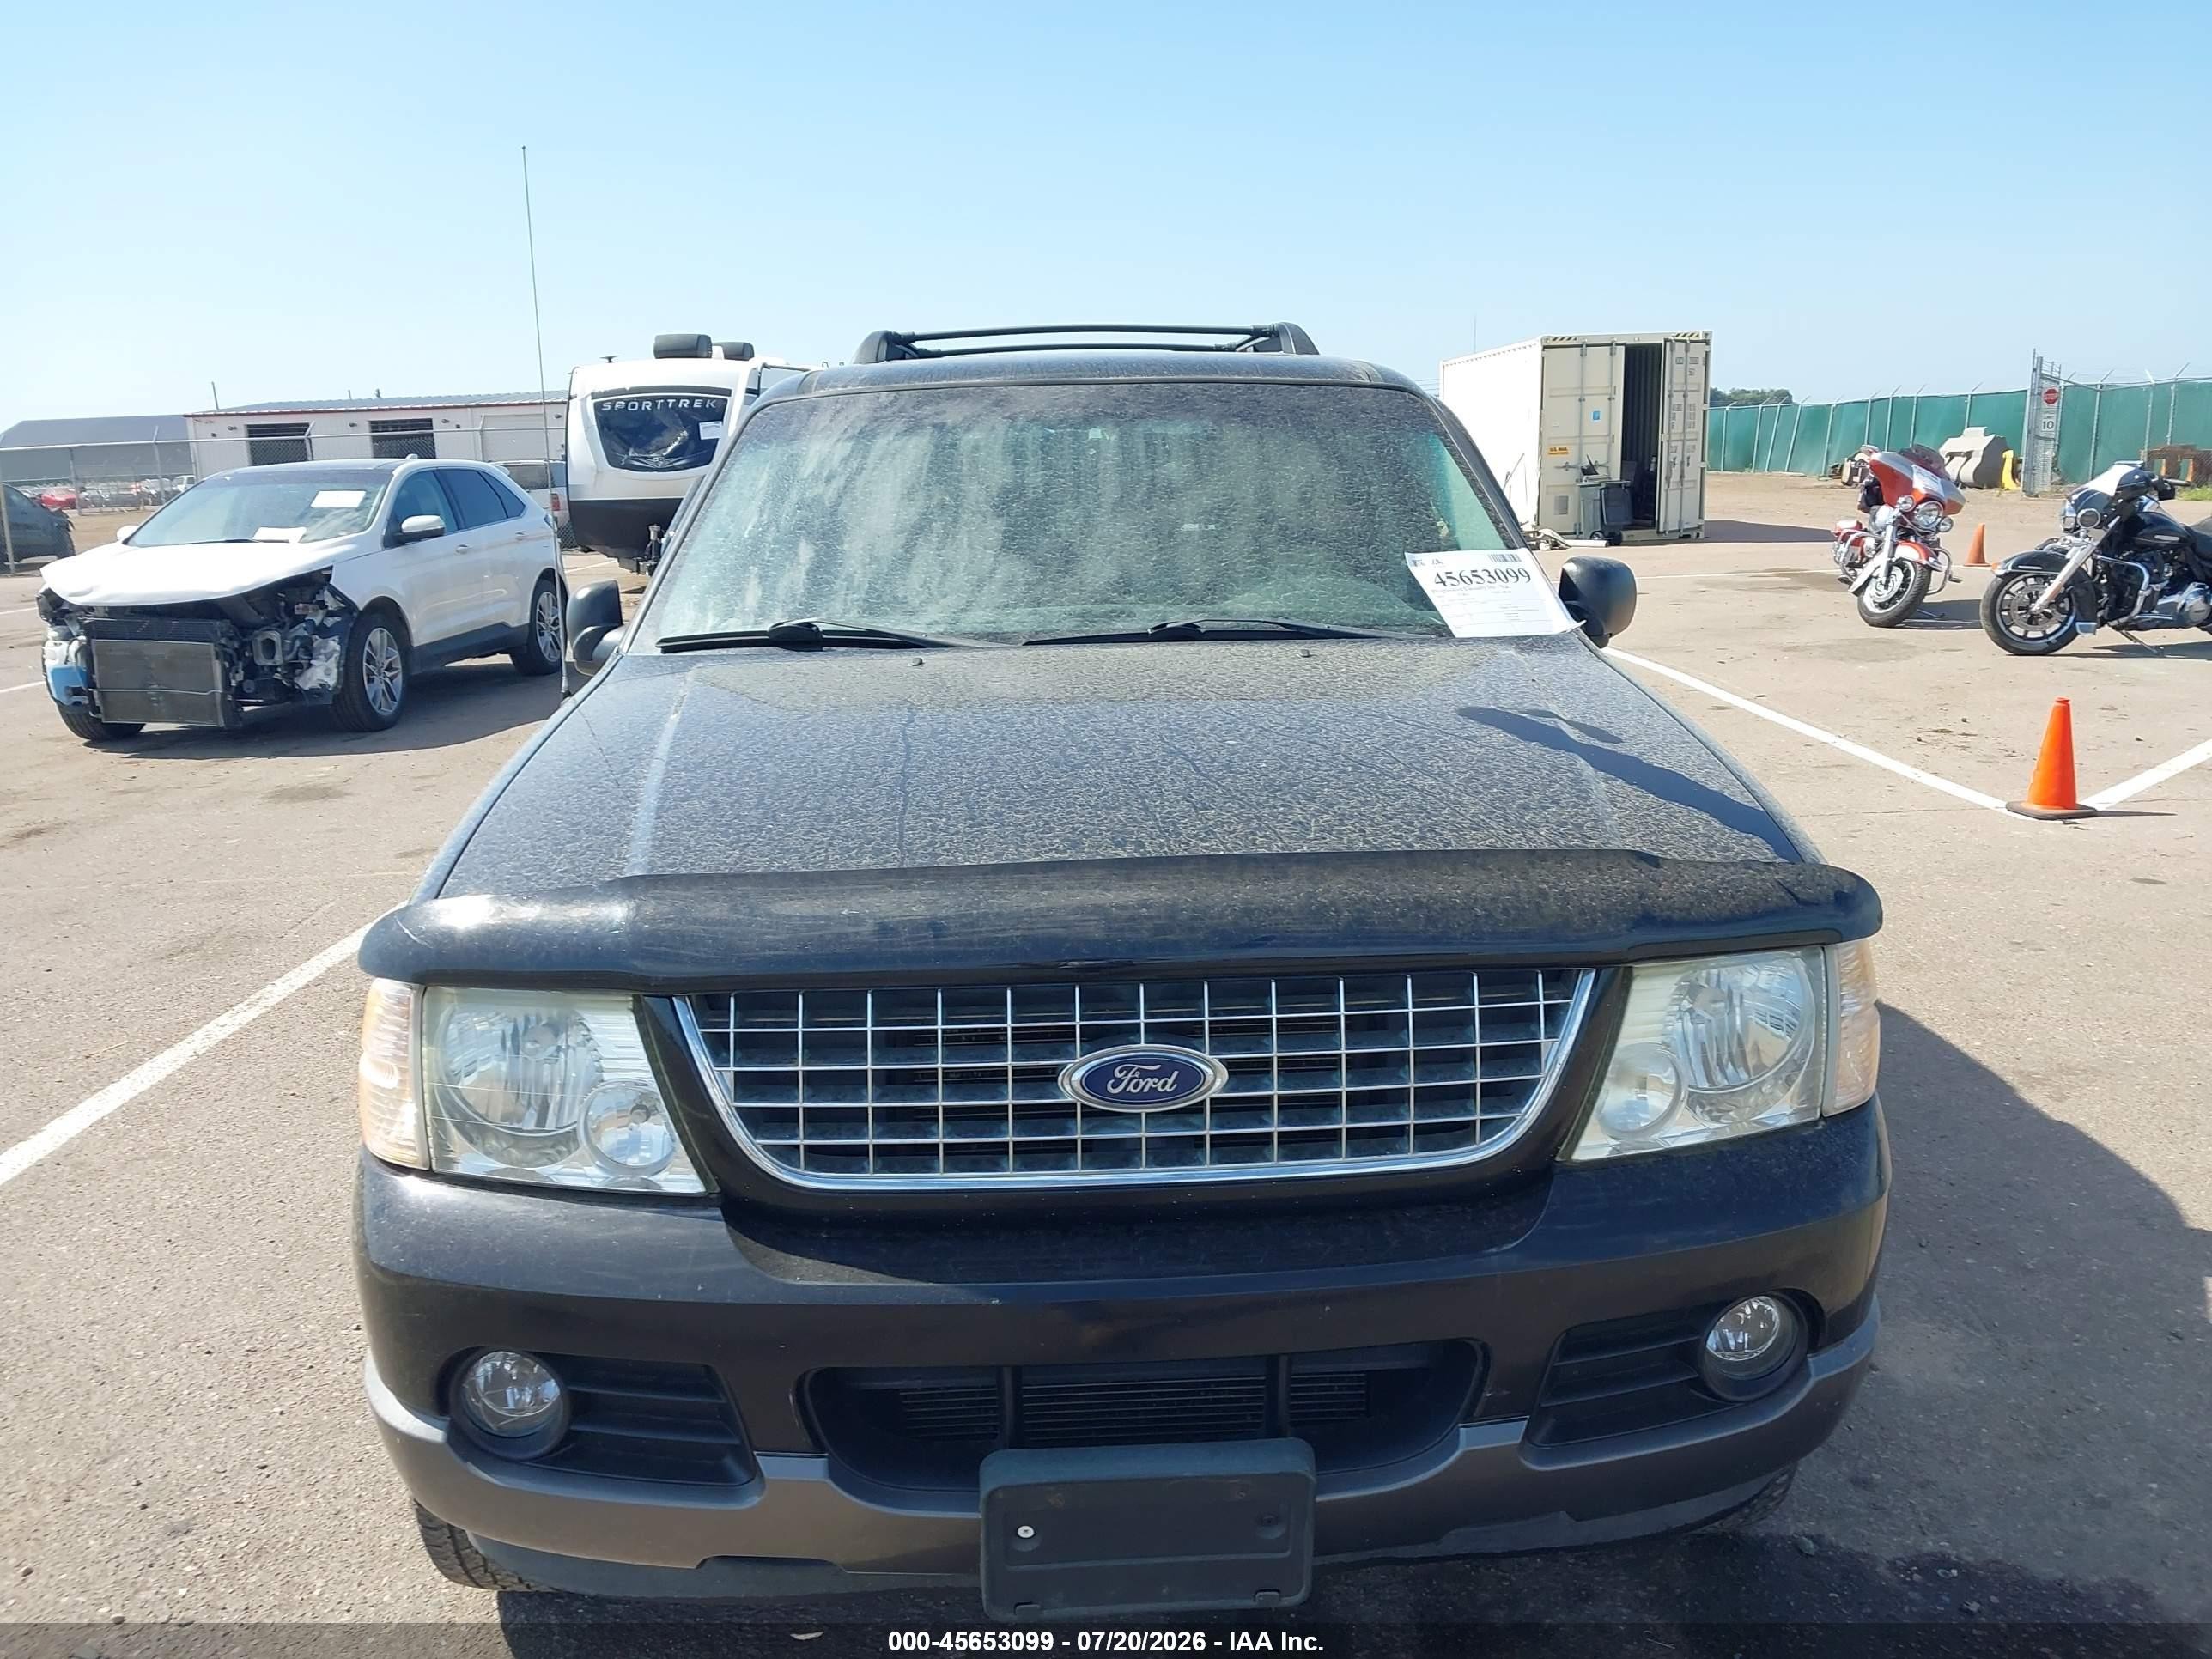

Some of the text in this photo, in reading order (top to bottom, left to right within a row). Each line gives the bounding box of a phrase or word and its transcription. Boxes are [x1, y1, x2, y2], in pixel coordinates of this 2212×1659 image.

[601, 398, 717, 411] SPORTTREK
[2042, 420, 2055, 430] 10
[1434, 567, 1531, 587] 45653099
[1106, 1063, 1180, 1095] Ford
